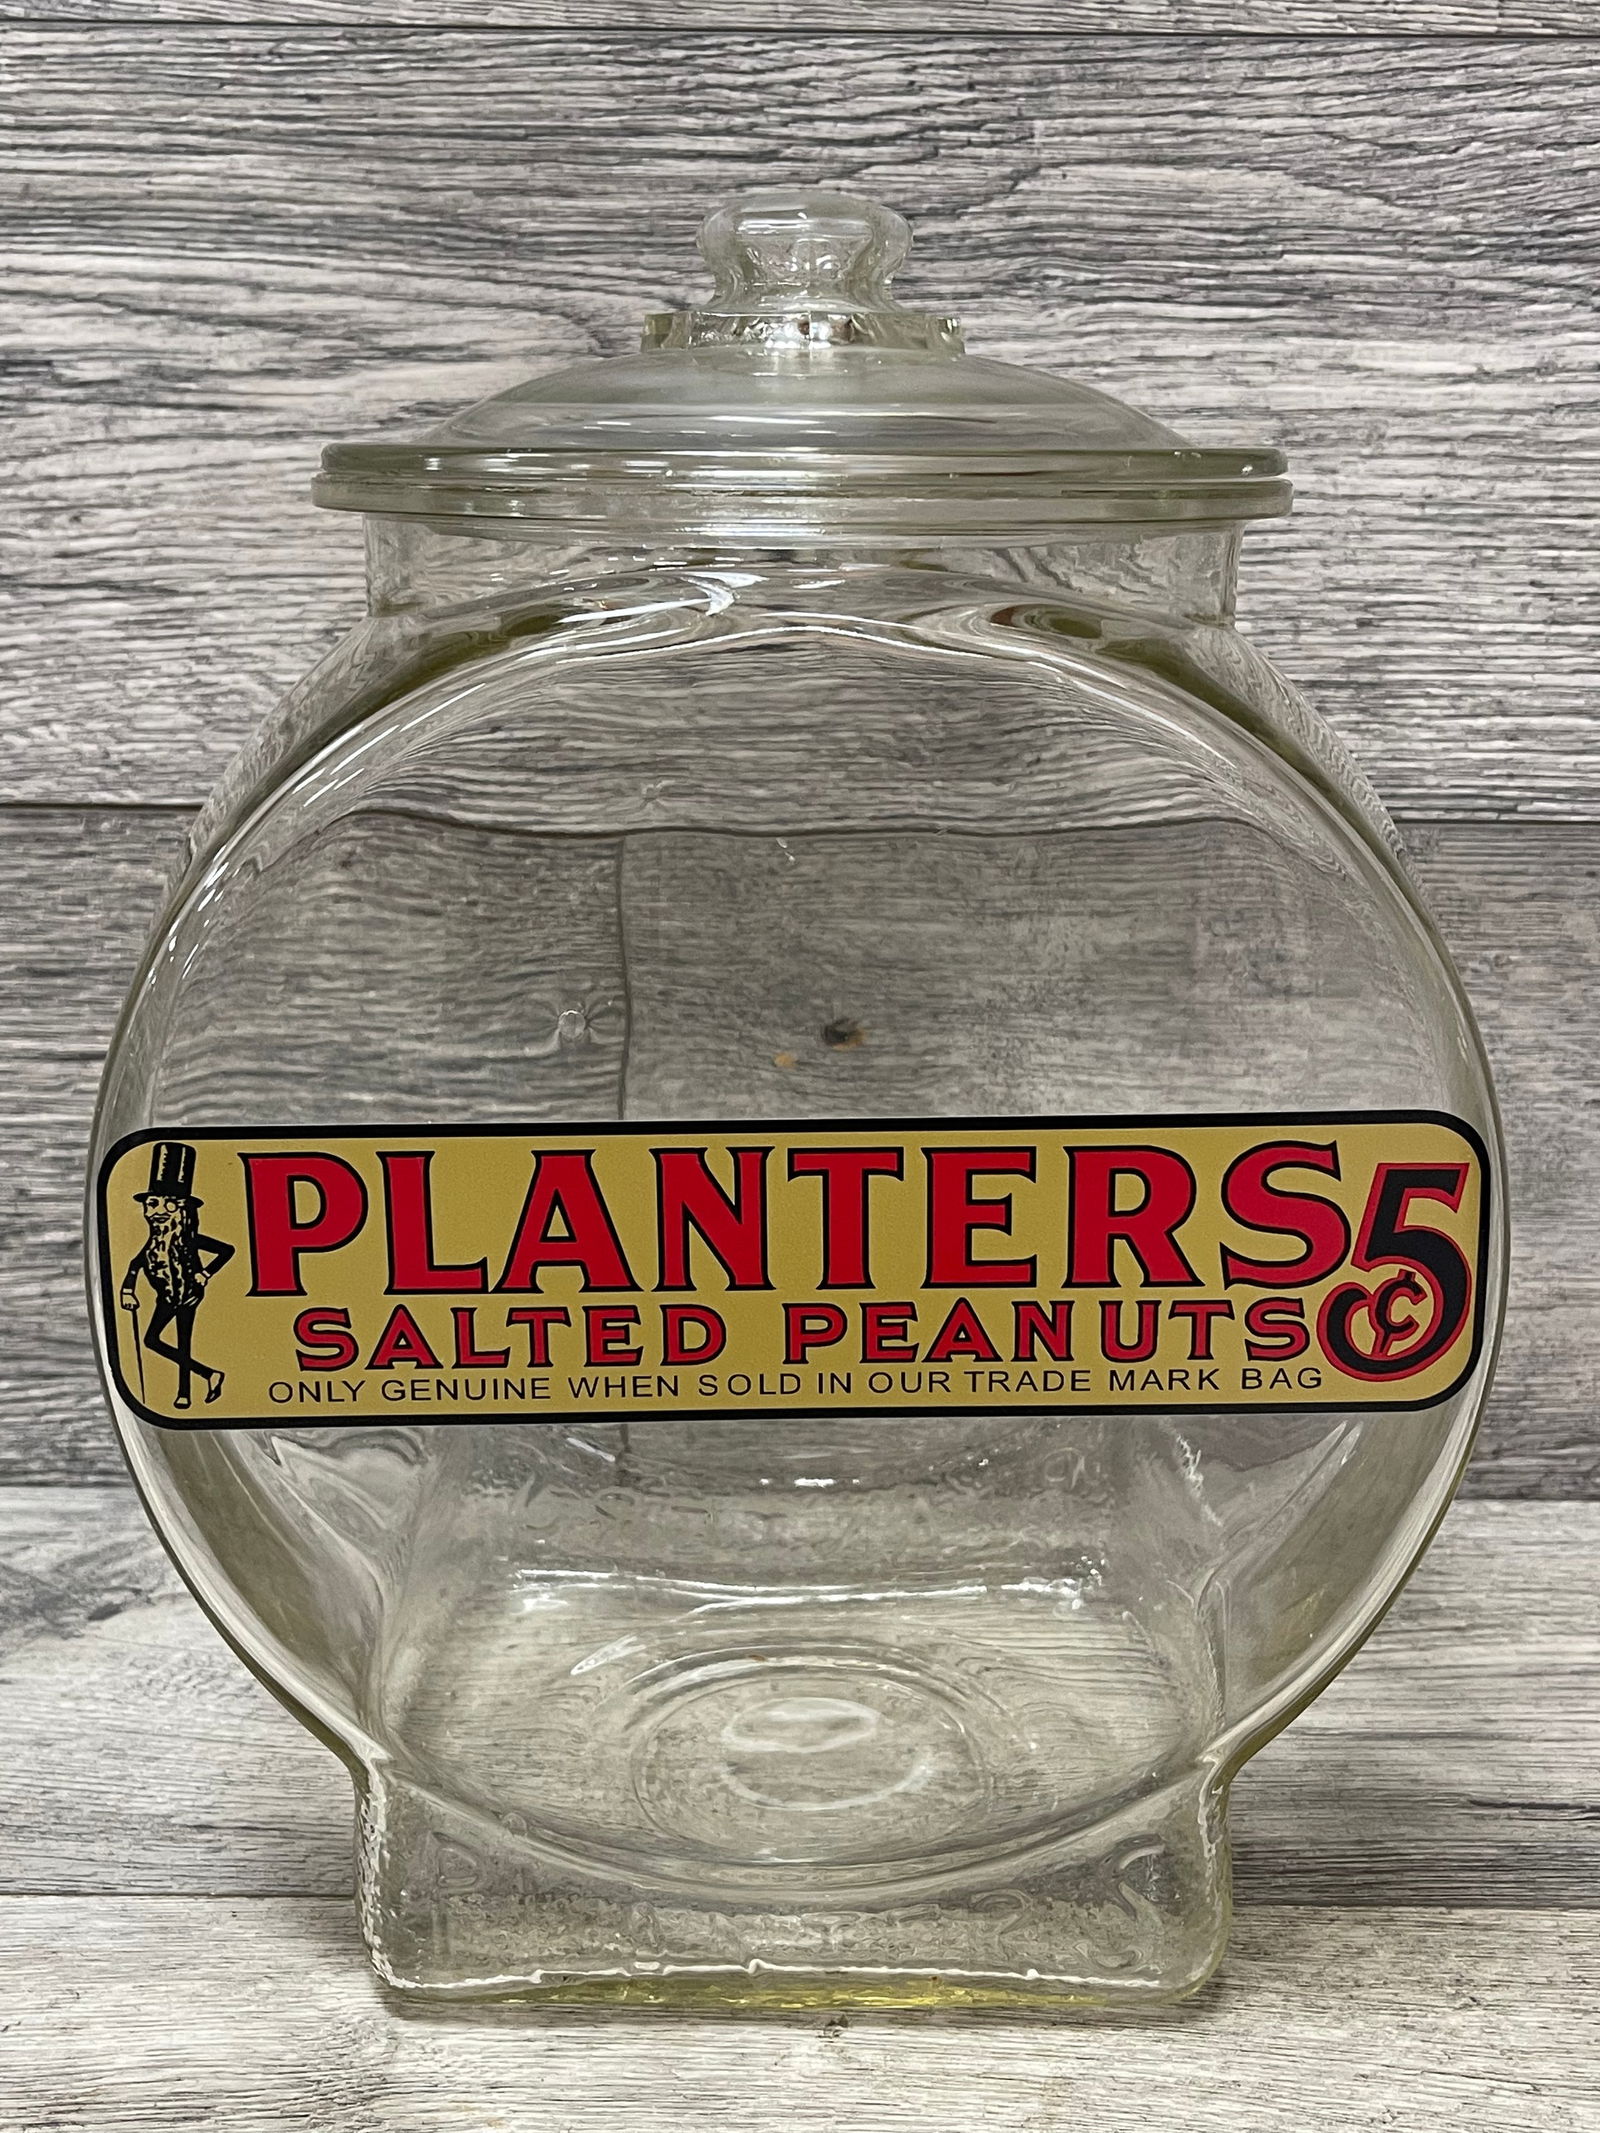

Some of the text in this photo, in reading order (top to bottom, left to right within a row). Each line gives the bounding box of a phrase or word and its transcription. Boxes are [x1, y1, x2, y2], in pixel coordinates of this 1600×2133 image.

[236, 1140, 1352, 1298] PLANTERS
[293, 1296, 1311, 1373] SALTED PEANUTS
[268, 1367, 1322, 1404] ONLY GENUINE WHEN SOLD IN OUR TRADE MARK BAG
